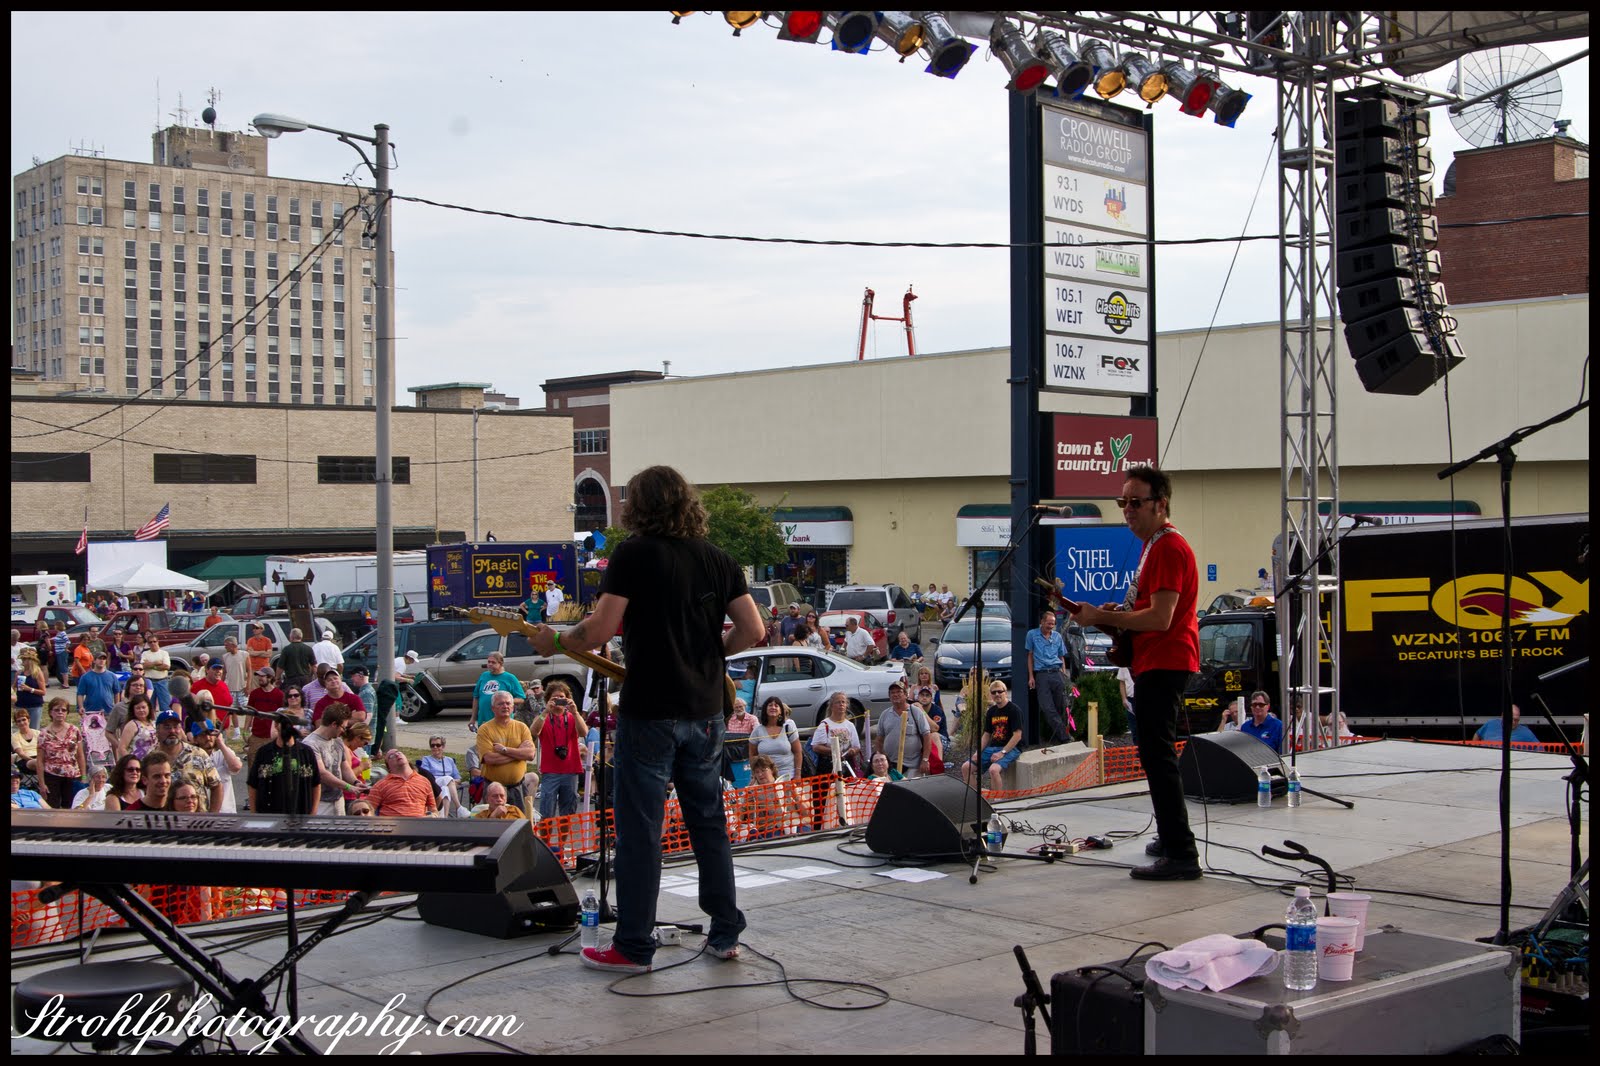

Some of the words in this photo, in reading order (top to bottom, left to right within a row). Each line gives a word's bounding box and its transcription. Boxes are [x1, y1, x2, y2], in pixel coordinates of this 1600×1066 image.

[1060, 117, 1131, 152] CROMWELL
[1060, 136, 1093, 156] RADIO
[1096, 144, 1132, 166] GROUP
[1057, 175, 1078, 192] 93.1
[1053, 196, 1084, 214] WYDS
[1056, 230, 1083, 246] 1009
[1054, 251, 1085, 269] WZUS
[1096, 249, 1113, 265] TALK
[1056, 287, 1082, 303] 105.1
[1056, 309, 1083, 325] WEJT
[1096, 299, 1124, 317] Classic
[1125, 303, 1140, 319] Hits
[1056, 343, 1083, 359] 106.7
[1101, 355, 1140, 371] FOX
[1053, 364, 1086, 381] WZNX
[1057, 442, 1091, 456] town
[1093, 441, 1105, 456] &
[1057, 458, 1111, 475] country
[1122, 458, 1154, 471] bank
[792, 534, 811, 542] bank
[474, 558, 519, 574] Magic
[1067, 546, 1114, 570] STIFEL
[486, 575, 504, 589] 98
[531, 573, 548, 584] THE
[1344, 570, 1589, 632] FOX
[1392, 631, 1460, 646] WZNX
[1468, 630, 1527, 643] 106.7
[1535, 628, 1571, 641] FM
[1398, 650, 1476, 661] DECATUR'S
[1521, 647, 1564, 657] ROCK
[1184, 697, 1219, 706] FOX
[262, 932, 323, 983] ULTIMATE
